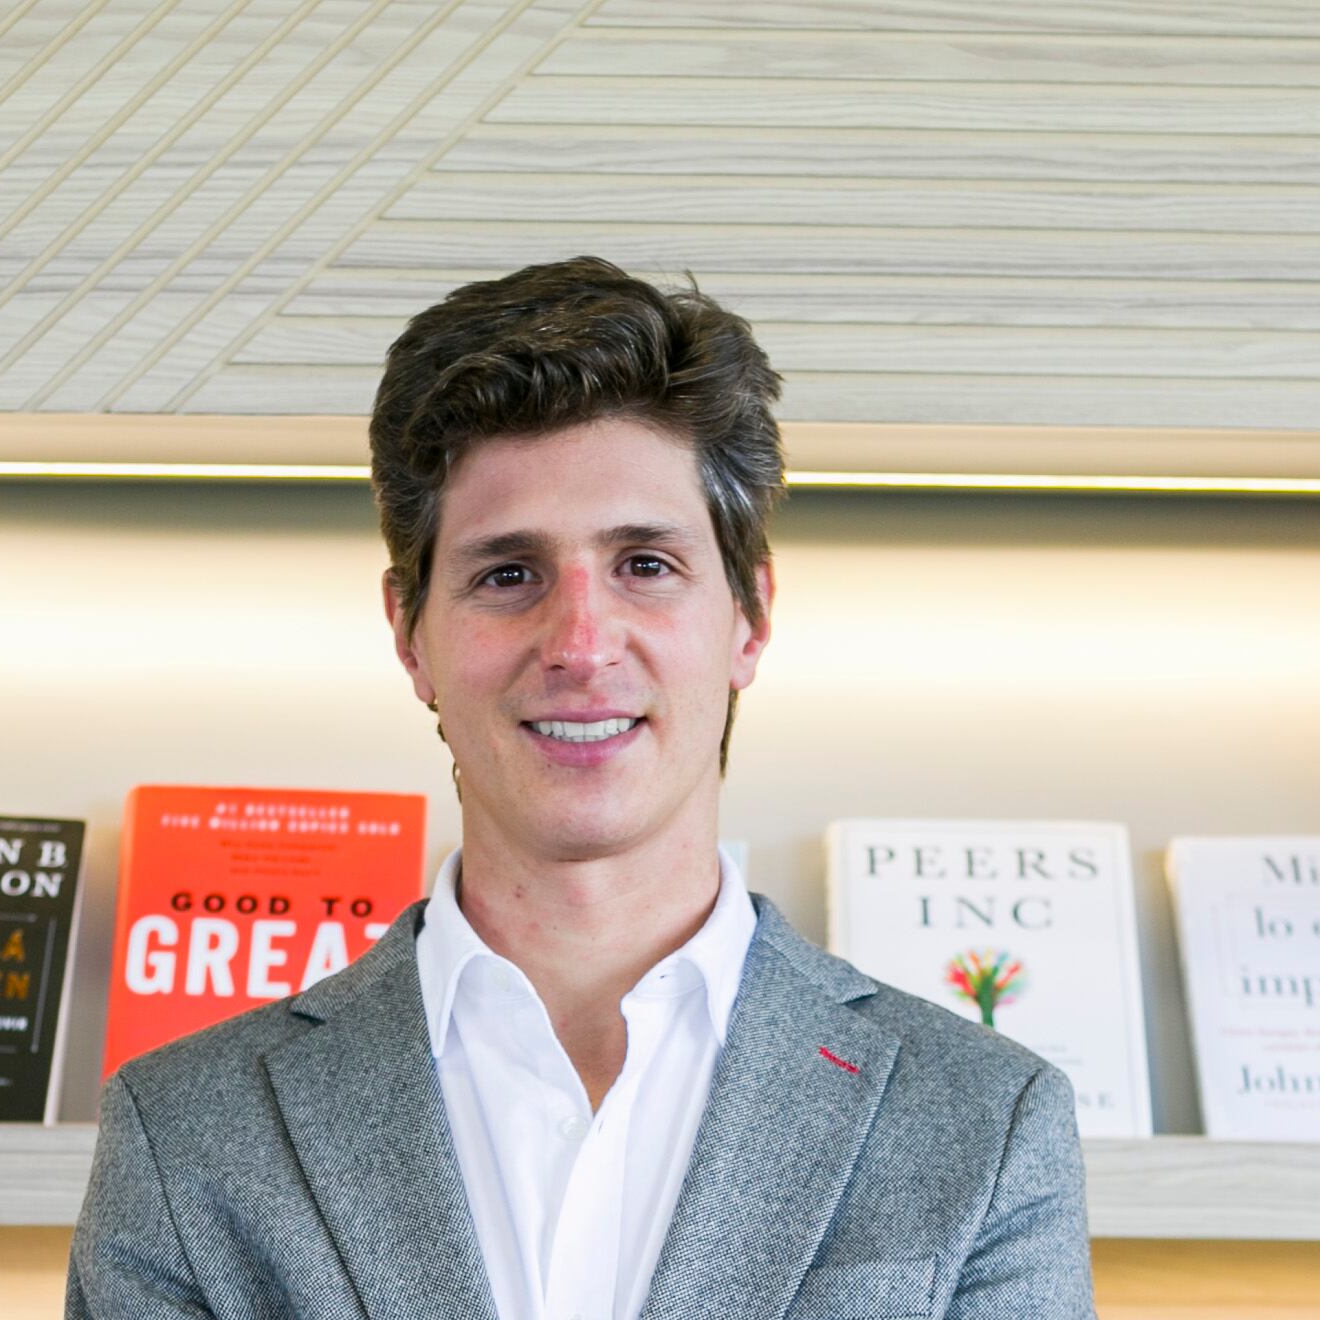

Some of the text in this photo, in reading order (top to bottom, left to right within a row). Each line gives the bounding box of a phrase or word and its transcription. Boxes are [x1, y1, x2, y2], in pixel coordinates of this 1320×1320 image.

[865, 845, 1100, 880] PEERS
[170, 892, 373, 917] GOOD TO
[918, 896, 1053, 930] INC
[1255, 906, 1294, 938] lo
